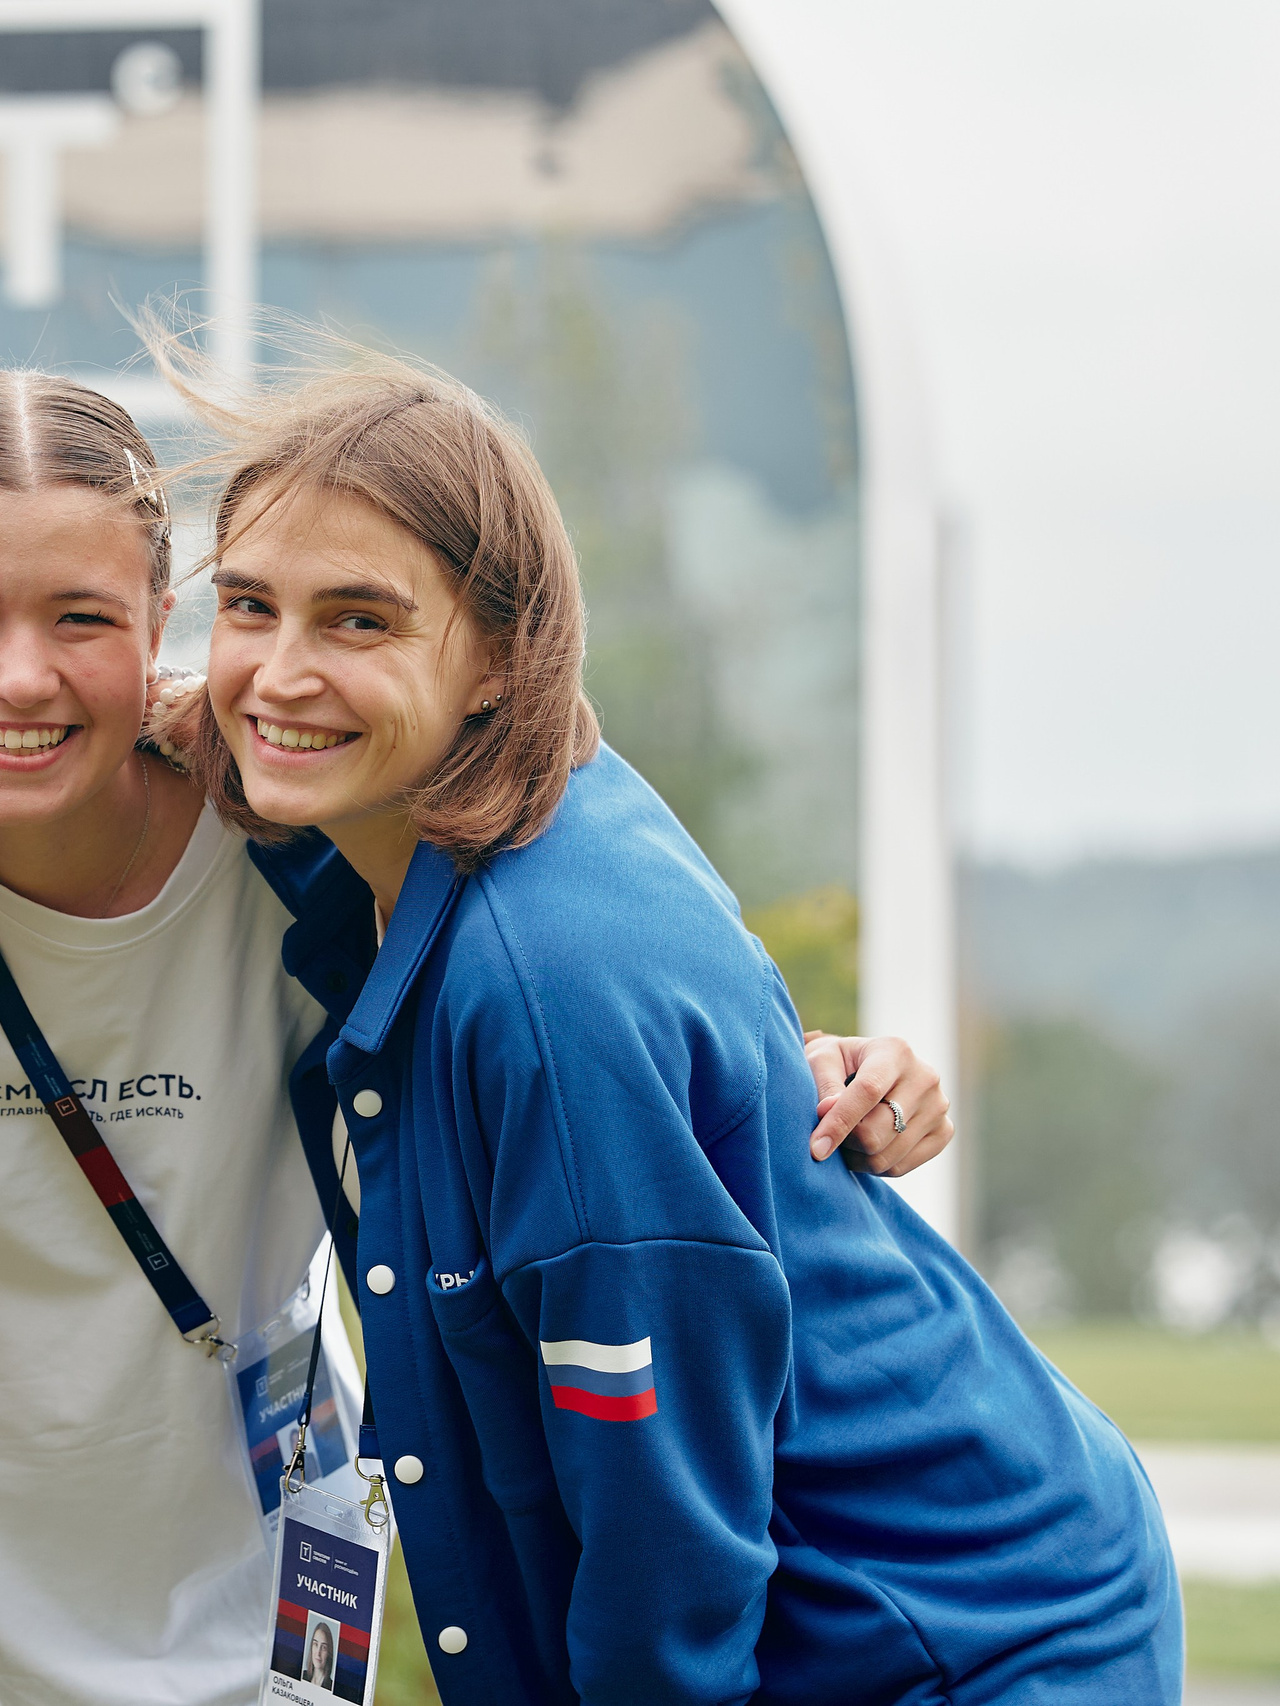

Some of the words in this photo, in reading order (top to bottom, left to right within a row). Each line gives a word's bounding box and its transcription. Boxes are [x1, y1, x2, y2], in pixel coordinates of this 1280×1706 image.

[119, 1074, 201, 1101] ЕСТЬ.
[110, 1109, 133, 1122] ГДЕ
[136, 1106, 184, 1119] ИСКАТЬ
[296, 1573, 358, 1610] УЧАСТНИК
[273, 1676, 293, 1690] ОЛЬГА
